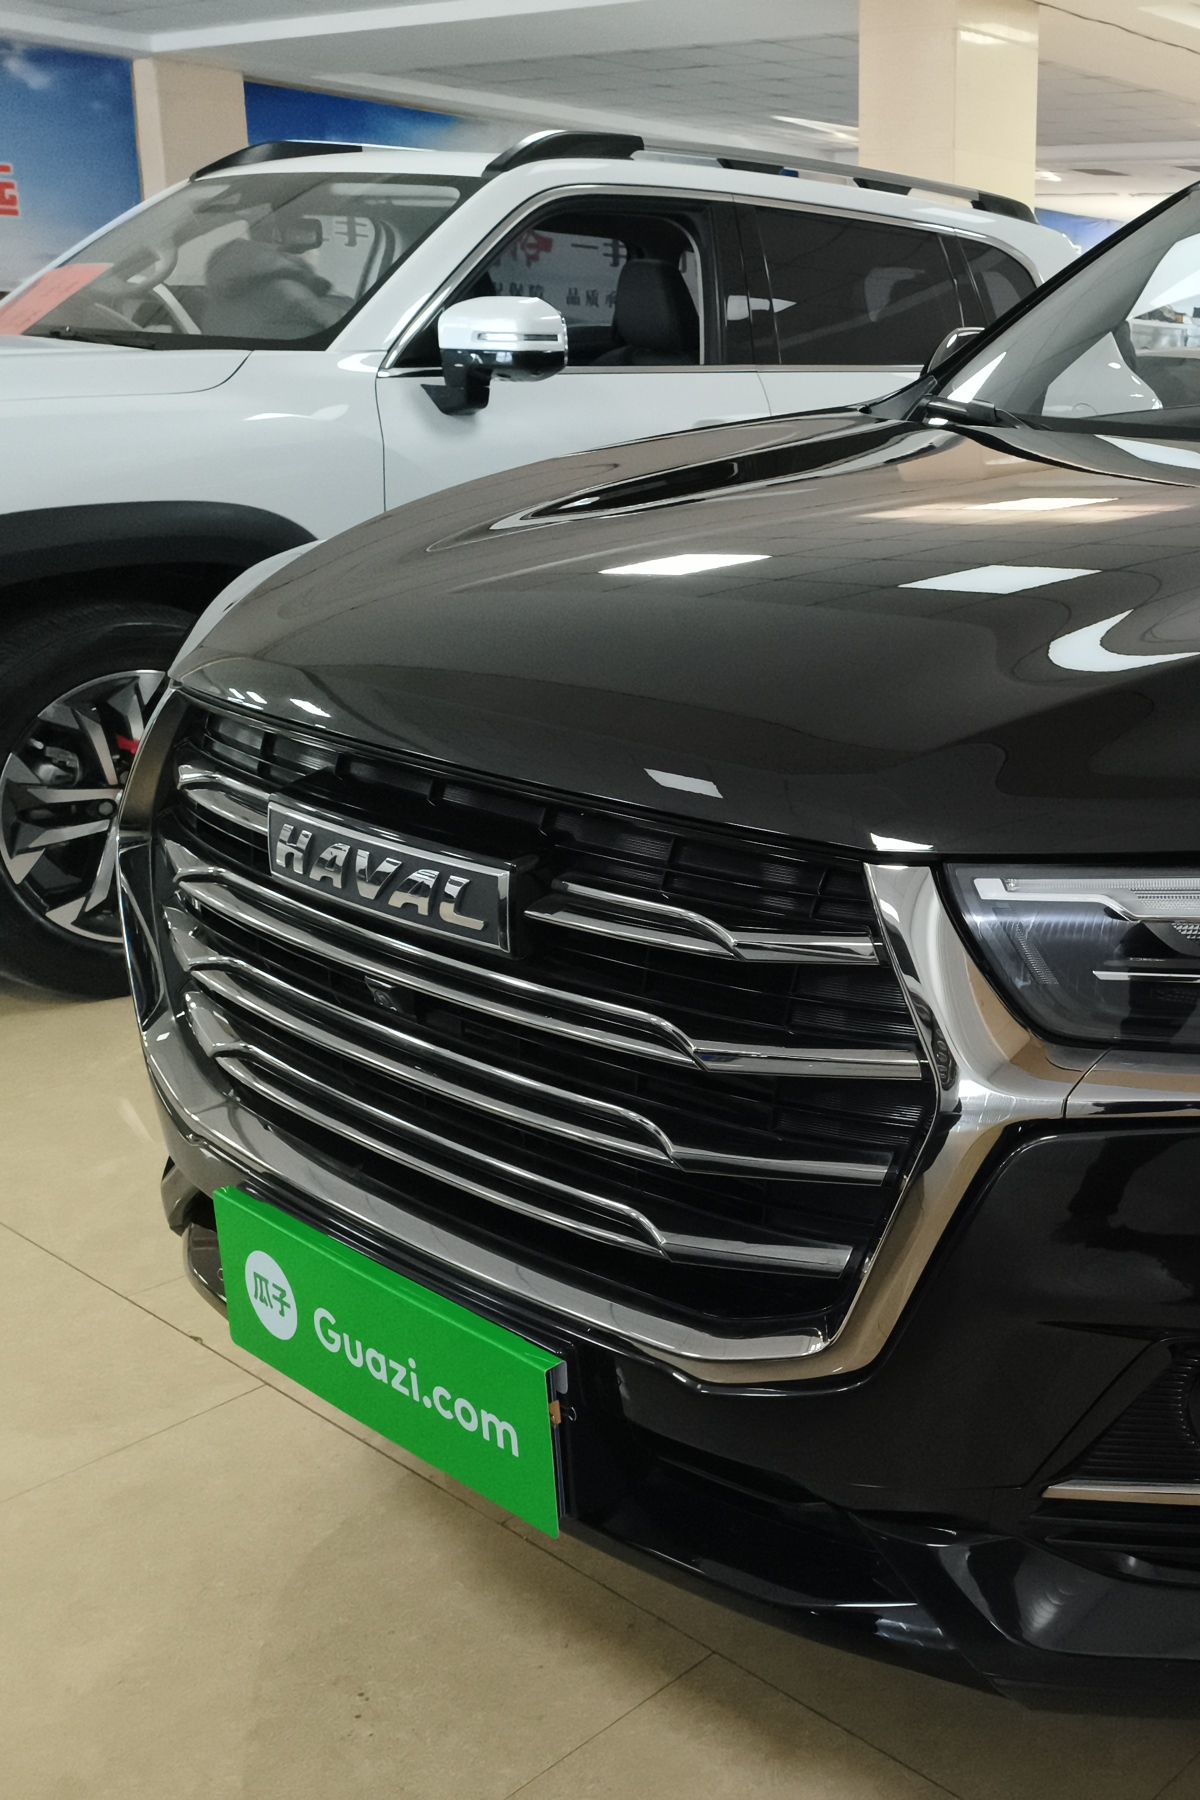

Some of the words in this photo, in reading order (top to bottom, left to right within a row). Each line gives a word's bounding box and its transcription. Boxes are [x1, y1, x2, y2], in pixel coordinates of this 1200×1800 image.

[275, 823, 485, 931] HAVAL
[253, 1271, 291, 1317] 瓜子
[313, 1307, 519, 1457] Guazi.com
